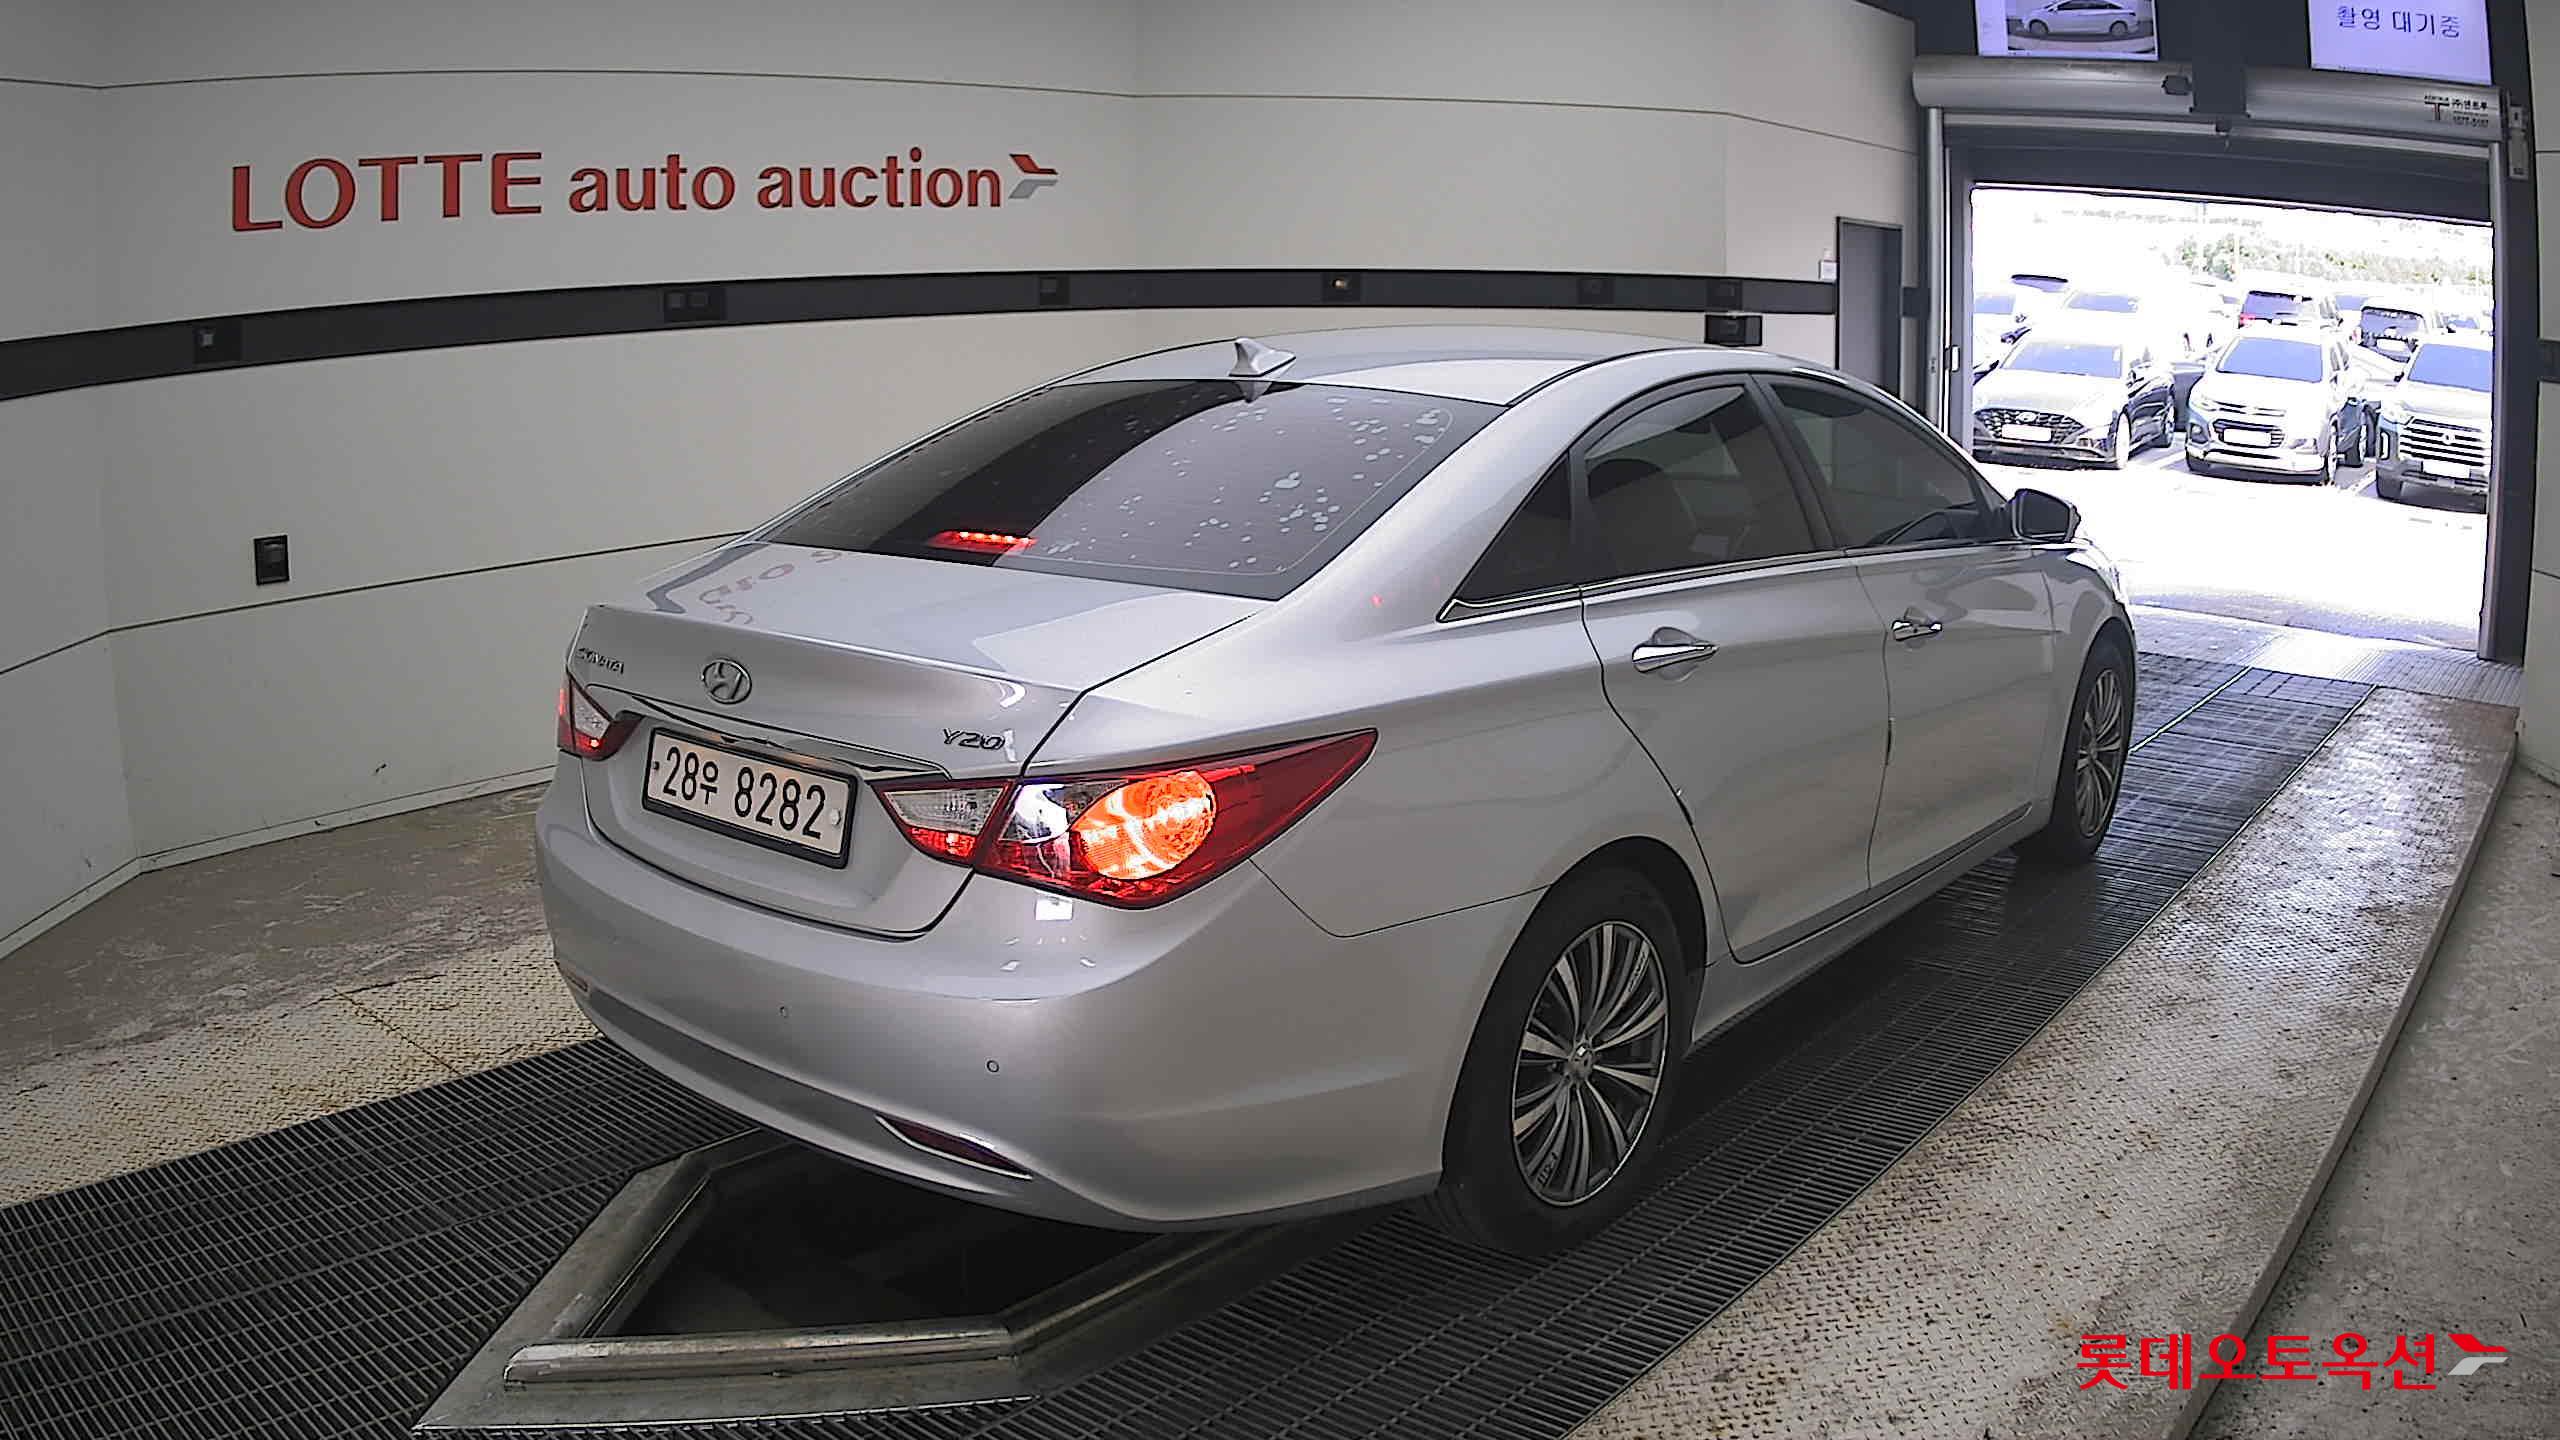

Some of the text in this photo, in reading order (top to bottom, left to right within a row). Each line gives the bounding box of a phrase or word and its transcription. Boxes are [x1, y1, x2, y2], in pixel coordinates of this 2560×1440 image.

[2337, 5, 2460, 39] 촬영 대기중
[233, 147, 1001, 231] LOTTE auto auction
[943, 728, 1006, 750] Y20
[663, 746, 826, 839] 28우 8282
